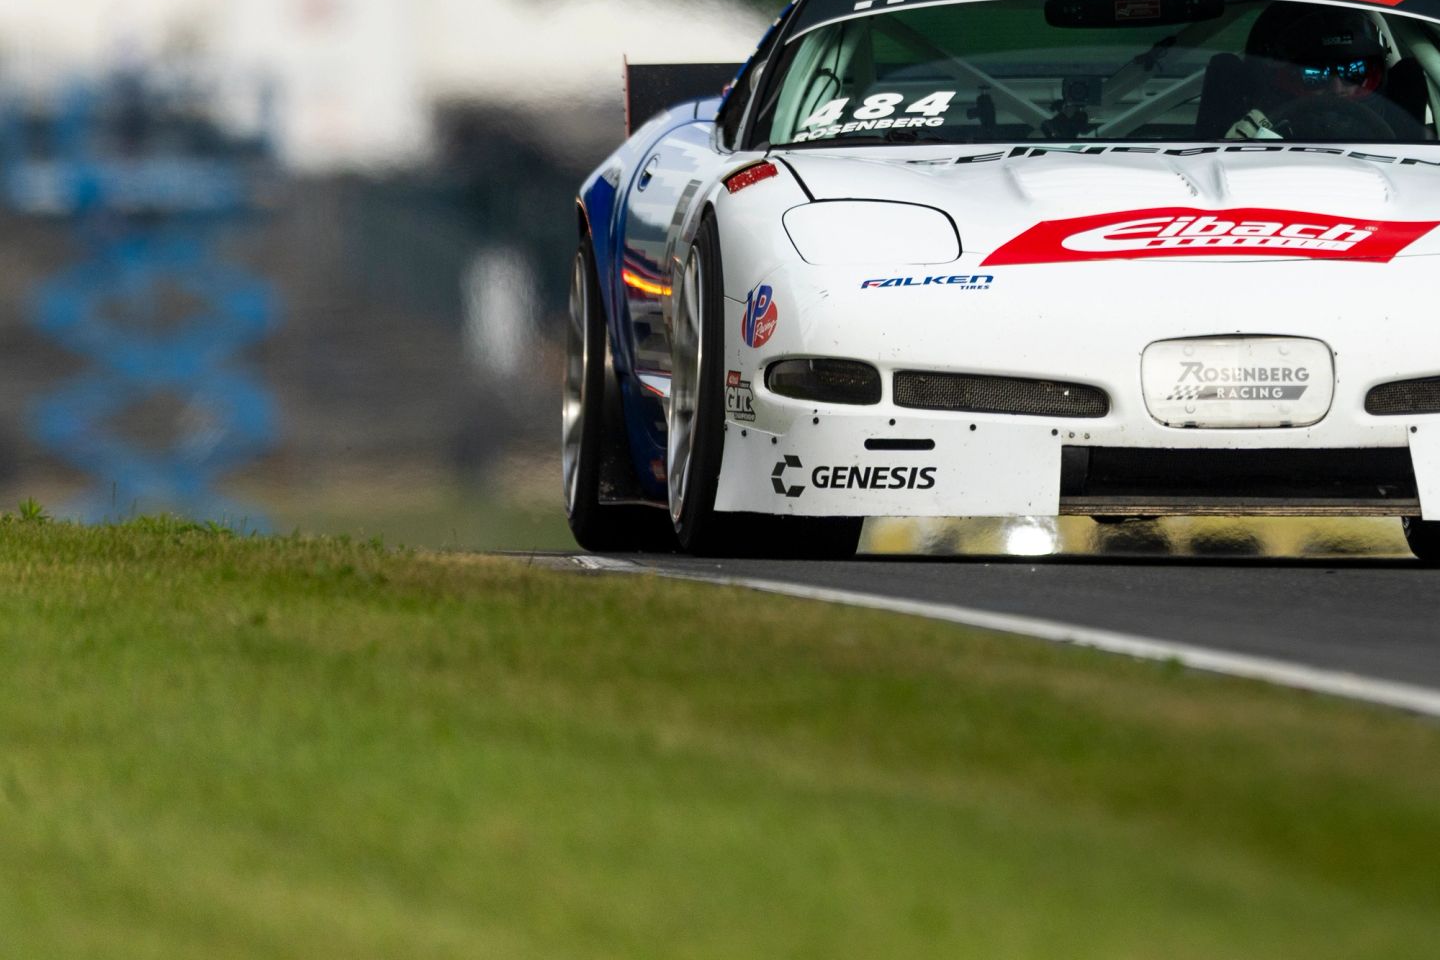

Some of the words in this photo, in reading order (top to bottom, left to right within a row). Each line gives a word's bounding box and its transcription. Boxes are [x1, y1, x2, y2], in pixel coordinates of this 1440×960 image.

[800, 91, 957, 128] 484
[792, 117, 945, 143] ROSENBERG
[1061, 216, 1373, 252] Eibach
[860, 275, 994, 289] FALKEN
[746, 285, 773, 348] VP
[1177, 361, 1310, 383] ROSENBERG
[1216, 387, 1284, 399] RACING
[811, 465, 938, 489] GENESIS
